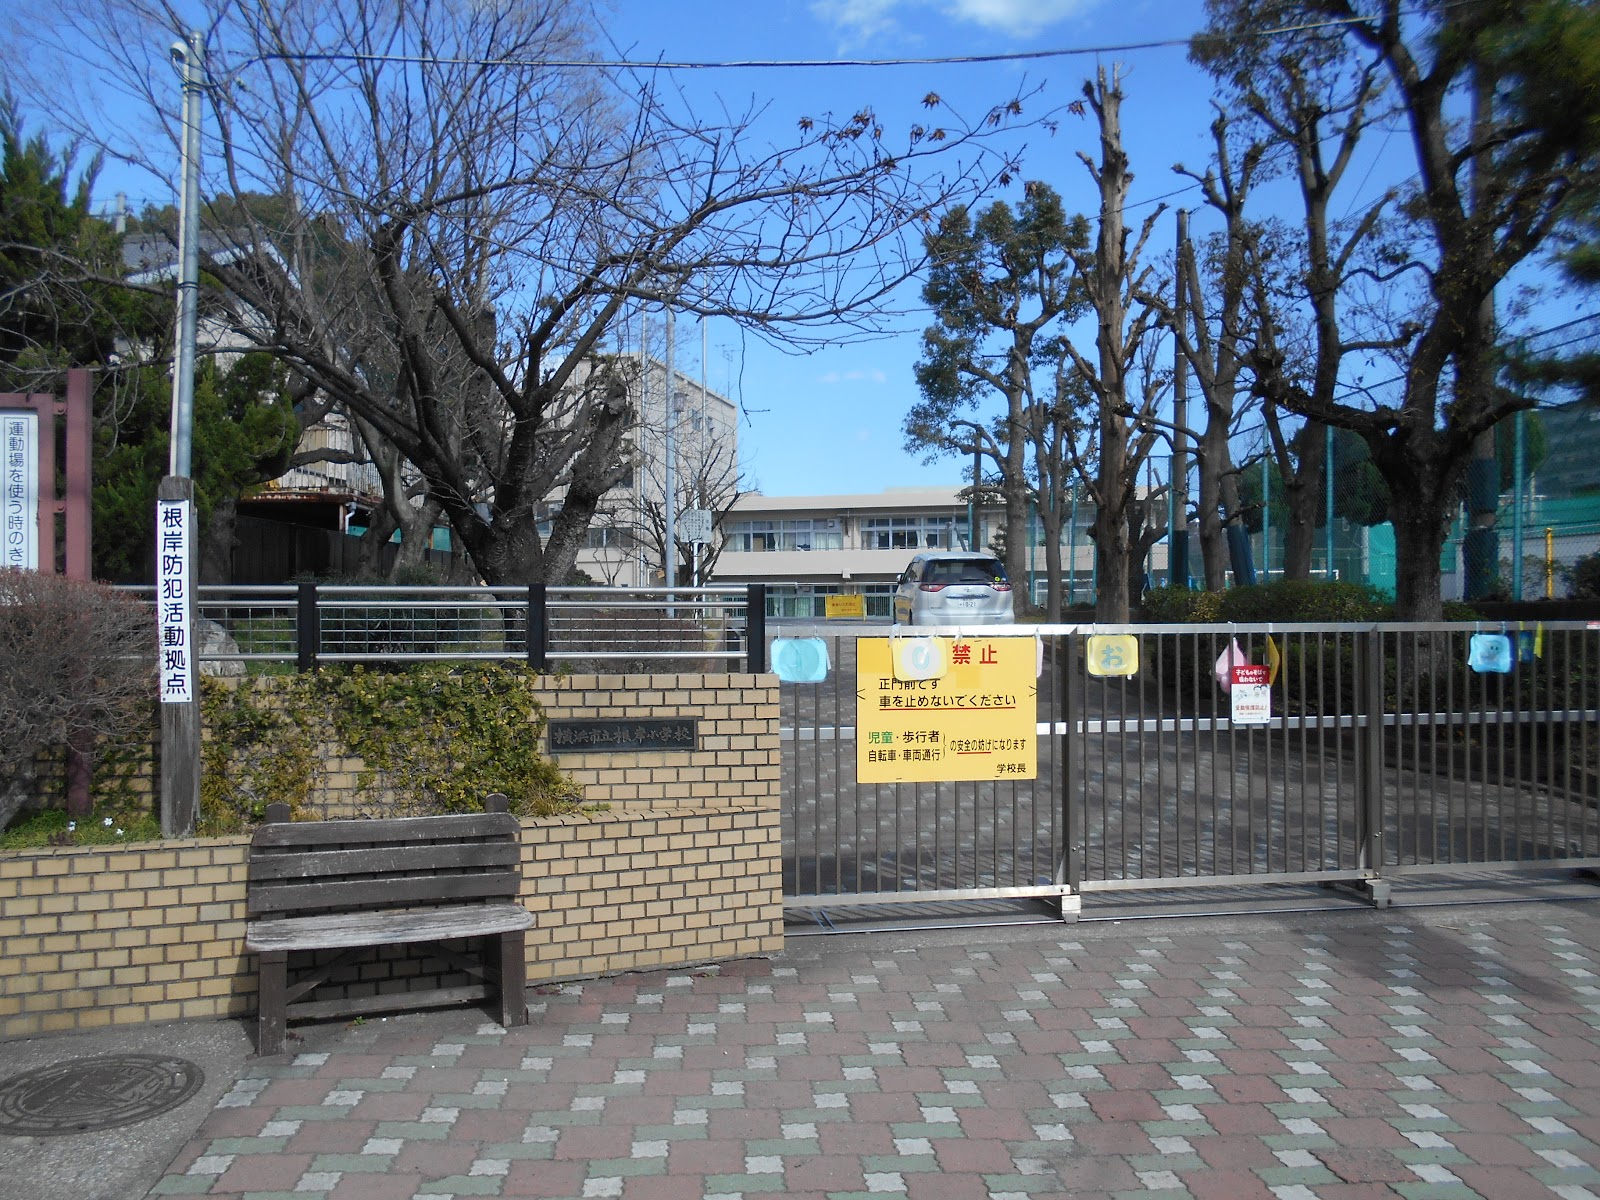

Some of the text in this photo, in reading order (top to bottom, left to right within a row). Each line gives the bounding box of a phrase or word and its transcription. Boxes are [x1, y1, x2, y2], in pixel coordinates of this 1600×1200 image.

[8, 421, 25, 569] 運動場を使う時のき
[163, 507, 187, 694] 根岸防犯活動拠点
[952, 644, 998, 665] 禁止
[1101, 644, 1123, 669] お
[879, 694, 1017, 708] 車を止めないでください
[553, 726, 692, 745] 横浜市立根岸小学校
[950, 739, 1026, 752] の安全の妨げになります
[996, 763, 1027, 773] 学校長
